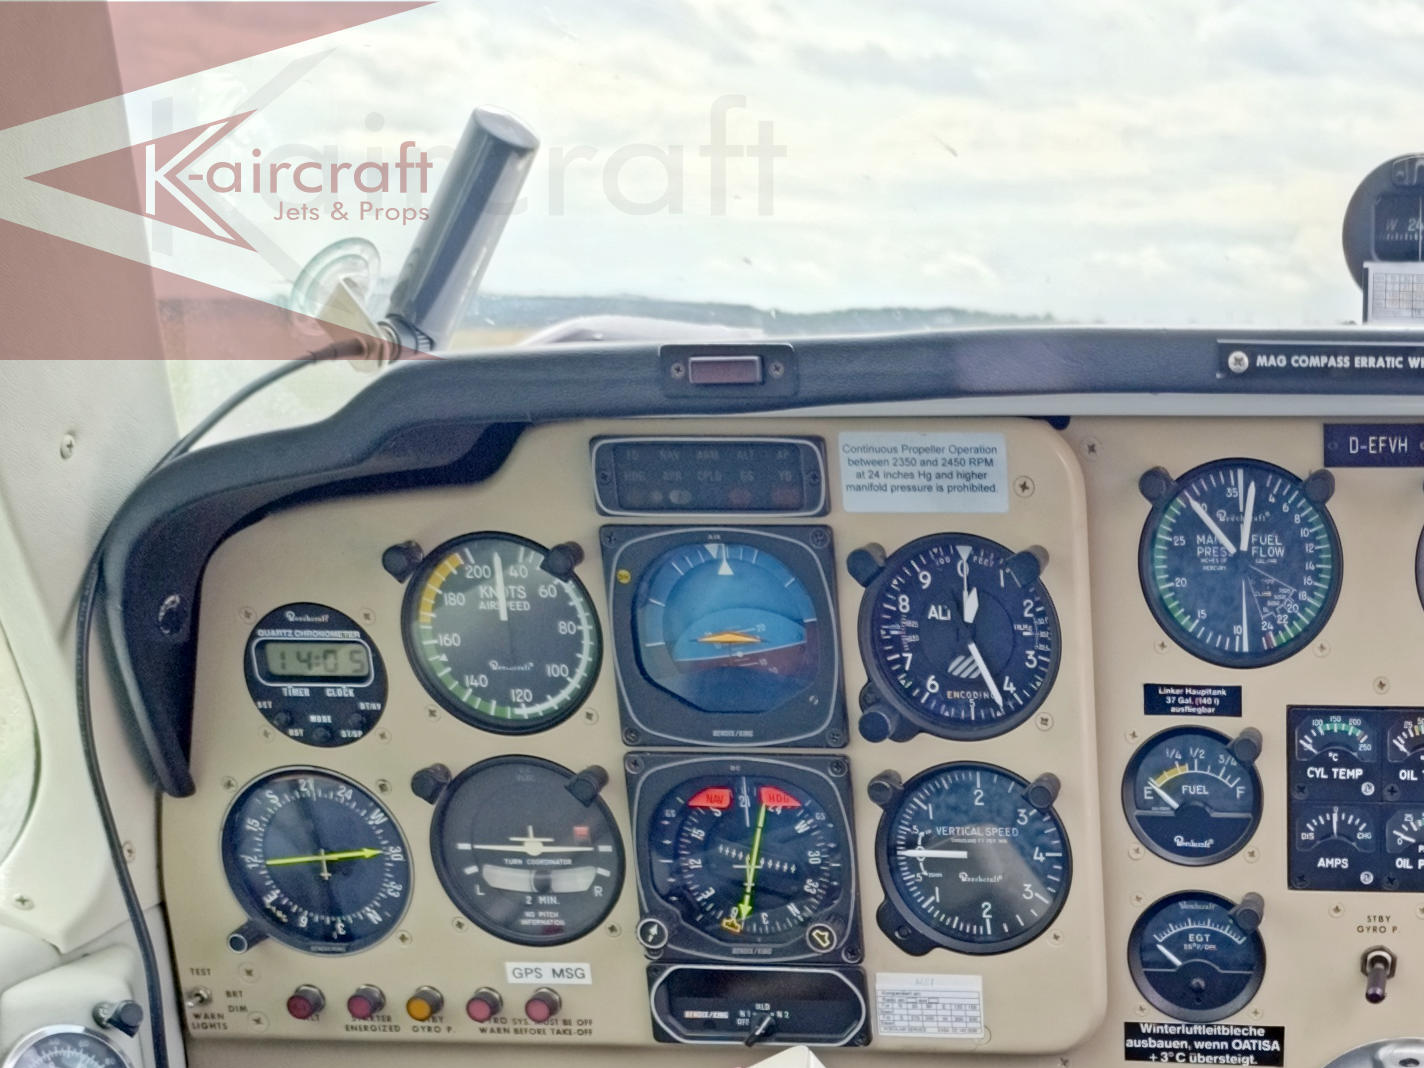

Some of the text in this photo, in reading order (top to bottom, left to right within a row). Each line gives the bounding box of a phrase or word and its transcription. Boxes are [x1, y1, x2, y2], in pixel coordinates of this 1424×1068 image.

[1256, 354, 1287, 368] MAG
[1291, 355, 1350, 369] COMPASS
[1354, 356, 1404, 369] ERRATIC
[842, 443, 998, 457] Continuous Propeller Operation
[1349, 436, 1408, 454] D-EFVH
[847, 457, 994, 468] between 2350 and 2450 RPM
[855, 470, 988, 483] at 24 inches Hg and higher
[846, 483, 998, 496] manifold pressure is prohibited.
[1173, 537, 1186, 547] 25
[1251, 534, 1283, 545] FUEL
[1251, 546, 1285, 558] FLOW
[465, 564, 492, 579] 200
[509, 564, 529, 579] 40
[1175, 578, 1187, 587] 20
[538, 584, 558, 599] 60
[443, 591, 467, 607] 180
[558, 621, 577, 636] 80
[437, 632, 462, 648] 160
[546, 663, 570, 679] 100
[464, 674, 489, 689] 140
[510, 688, 534, 704] 120
[1157, 686, 1184, 697] Linker
[1169, 704, 1216, 715] ausfliegbar
[1307, 767, 1364, 780] CYL TEMP
[1399, 769, 1418, 781] OIL
[1181, 784, 1209, 795] FUEL
[1016, 808, 1029, 825] 3
[935, 826, 1020, 837] VERTICAL SPEED
[1317, 857, 1349, 869] AMPS
[1395, 858, 1413, 870] OIL
[1022, 884, 1034, 900] 3
[981, 902, 993, 919] 2
[1367, 915, 1391, 923] STBY
[1356, 925, 1387, 934] GYRO
[1188, 932, 1211, 943] EGT
[190, 967, 212, 976] TEST
[512, 966, 586, 980] GPS MSG
[228, 1004, 248, 1013] DIM
[192, 1012, 225, 1020] WARN
[191, 1021, 229, 1030] LIGHTS
[345, 1024, 401, 1033] ENERGIZED
[479, 1026, 594, 1037] WARN BEFORE TAKE-OFF
[1140, 1022, 1265, 1038] Winterluftleitbleche
[1125, 1037, 1281, 1052] ausbauen, wenn OATISA
[1188, 1051, 1258, 1067] übersteigt.
